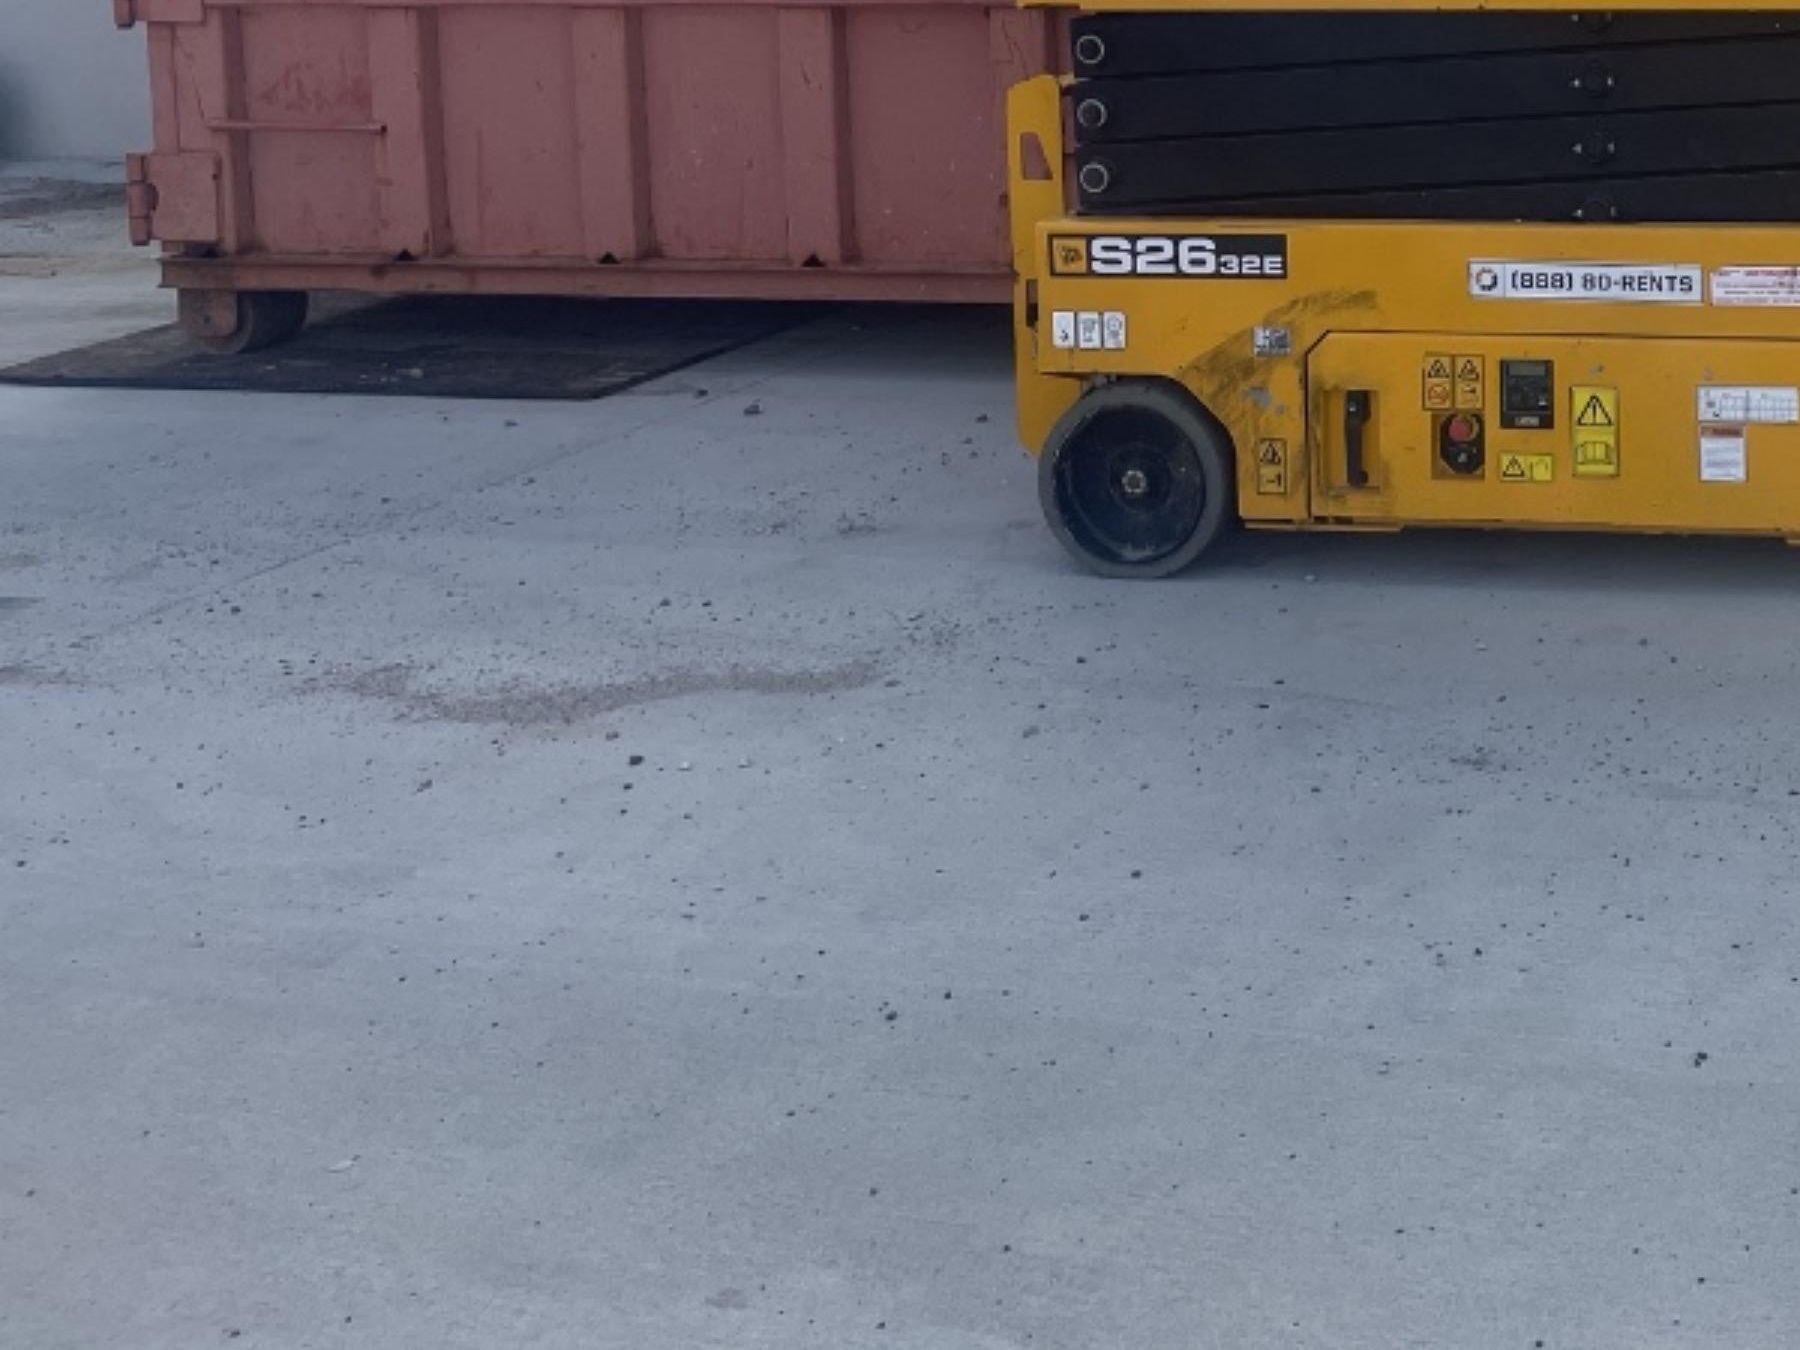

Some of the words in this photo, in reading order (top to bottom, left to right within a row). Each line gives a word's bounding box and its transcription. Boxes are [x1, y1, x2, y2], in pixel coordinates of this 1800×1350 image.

[1091, 236, 1217, 275] S26
[1219, 254, 1284, 274] 32E
[1511, 270, 1573, 291] (888)
